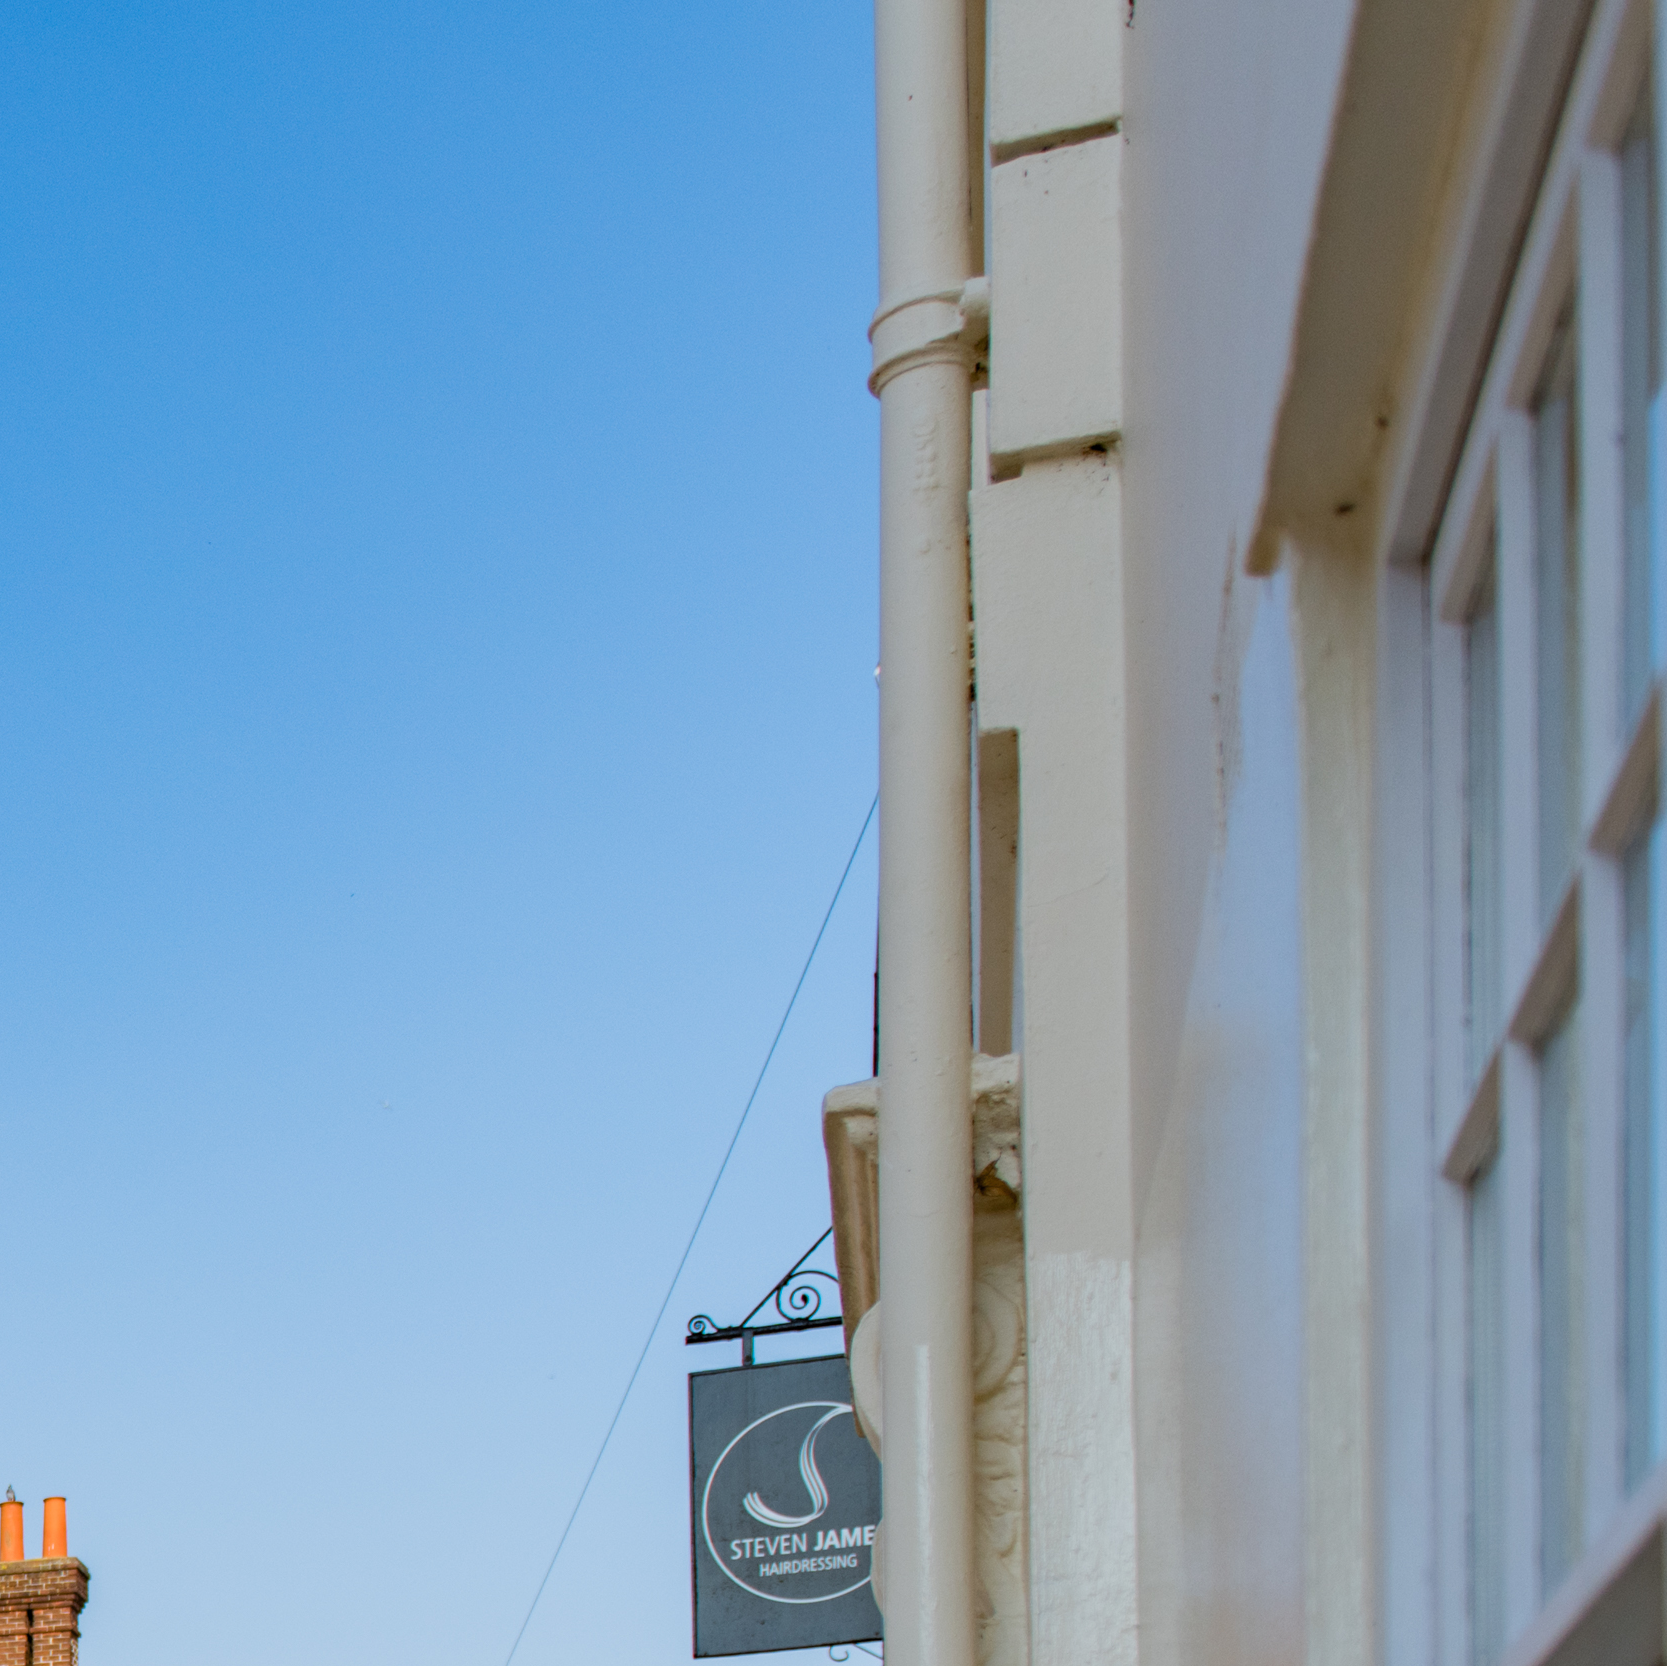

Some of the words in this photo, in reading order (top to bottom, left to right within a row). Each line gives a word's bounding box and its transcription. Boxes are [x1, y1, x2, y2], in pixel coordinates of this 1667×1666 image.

[730, 1532, 807, 1560] STEVEN
[813, 1524, 876, 1552] JAME
[759, 1553, 858, 1577] HAIRDRESSING
